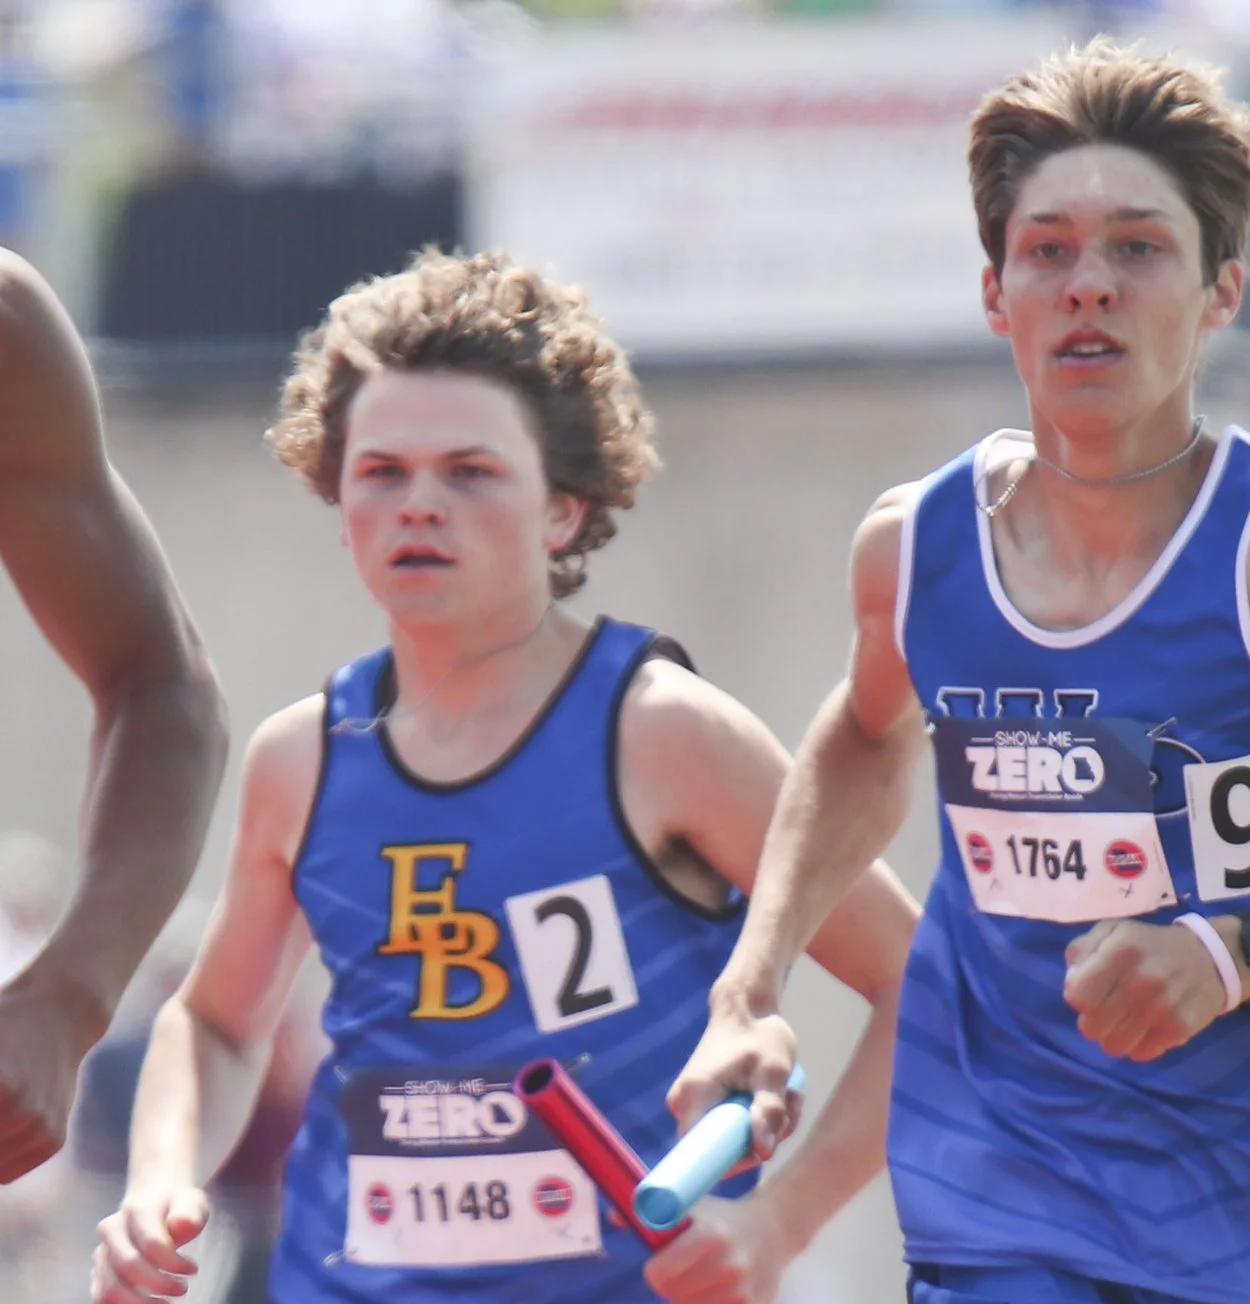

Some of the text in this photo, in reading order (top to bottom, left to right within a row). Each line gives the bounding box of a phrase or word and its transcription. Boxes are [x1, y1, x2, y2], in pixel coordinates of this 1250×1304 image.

[995, 730, 1072, 747] SHOW-ME
[964, 746, 1105, 793] ZERO
[1006, 834, 1087, 880] 1764
[534, 895, 614, 1017] 2
[379, 1091, 526, 1139] ZERO
[408, 1180, 511, 1222] 1148
